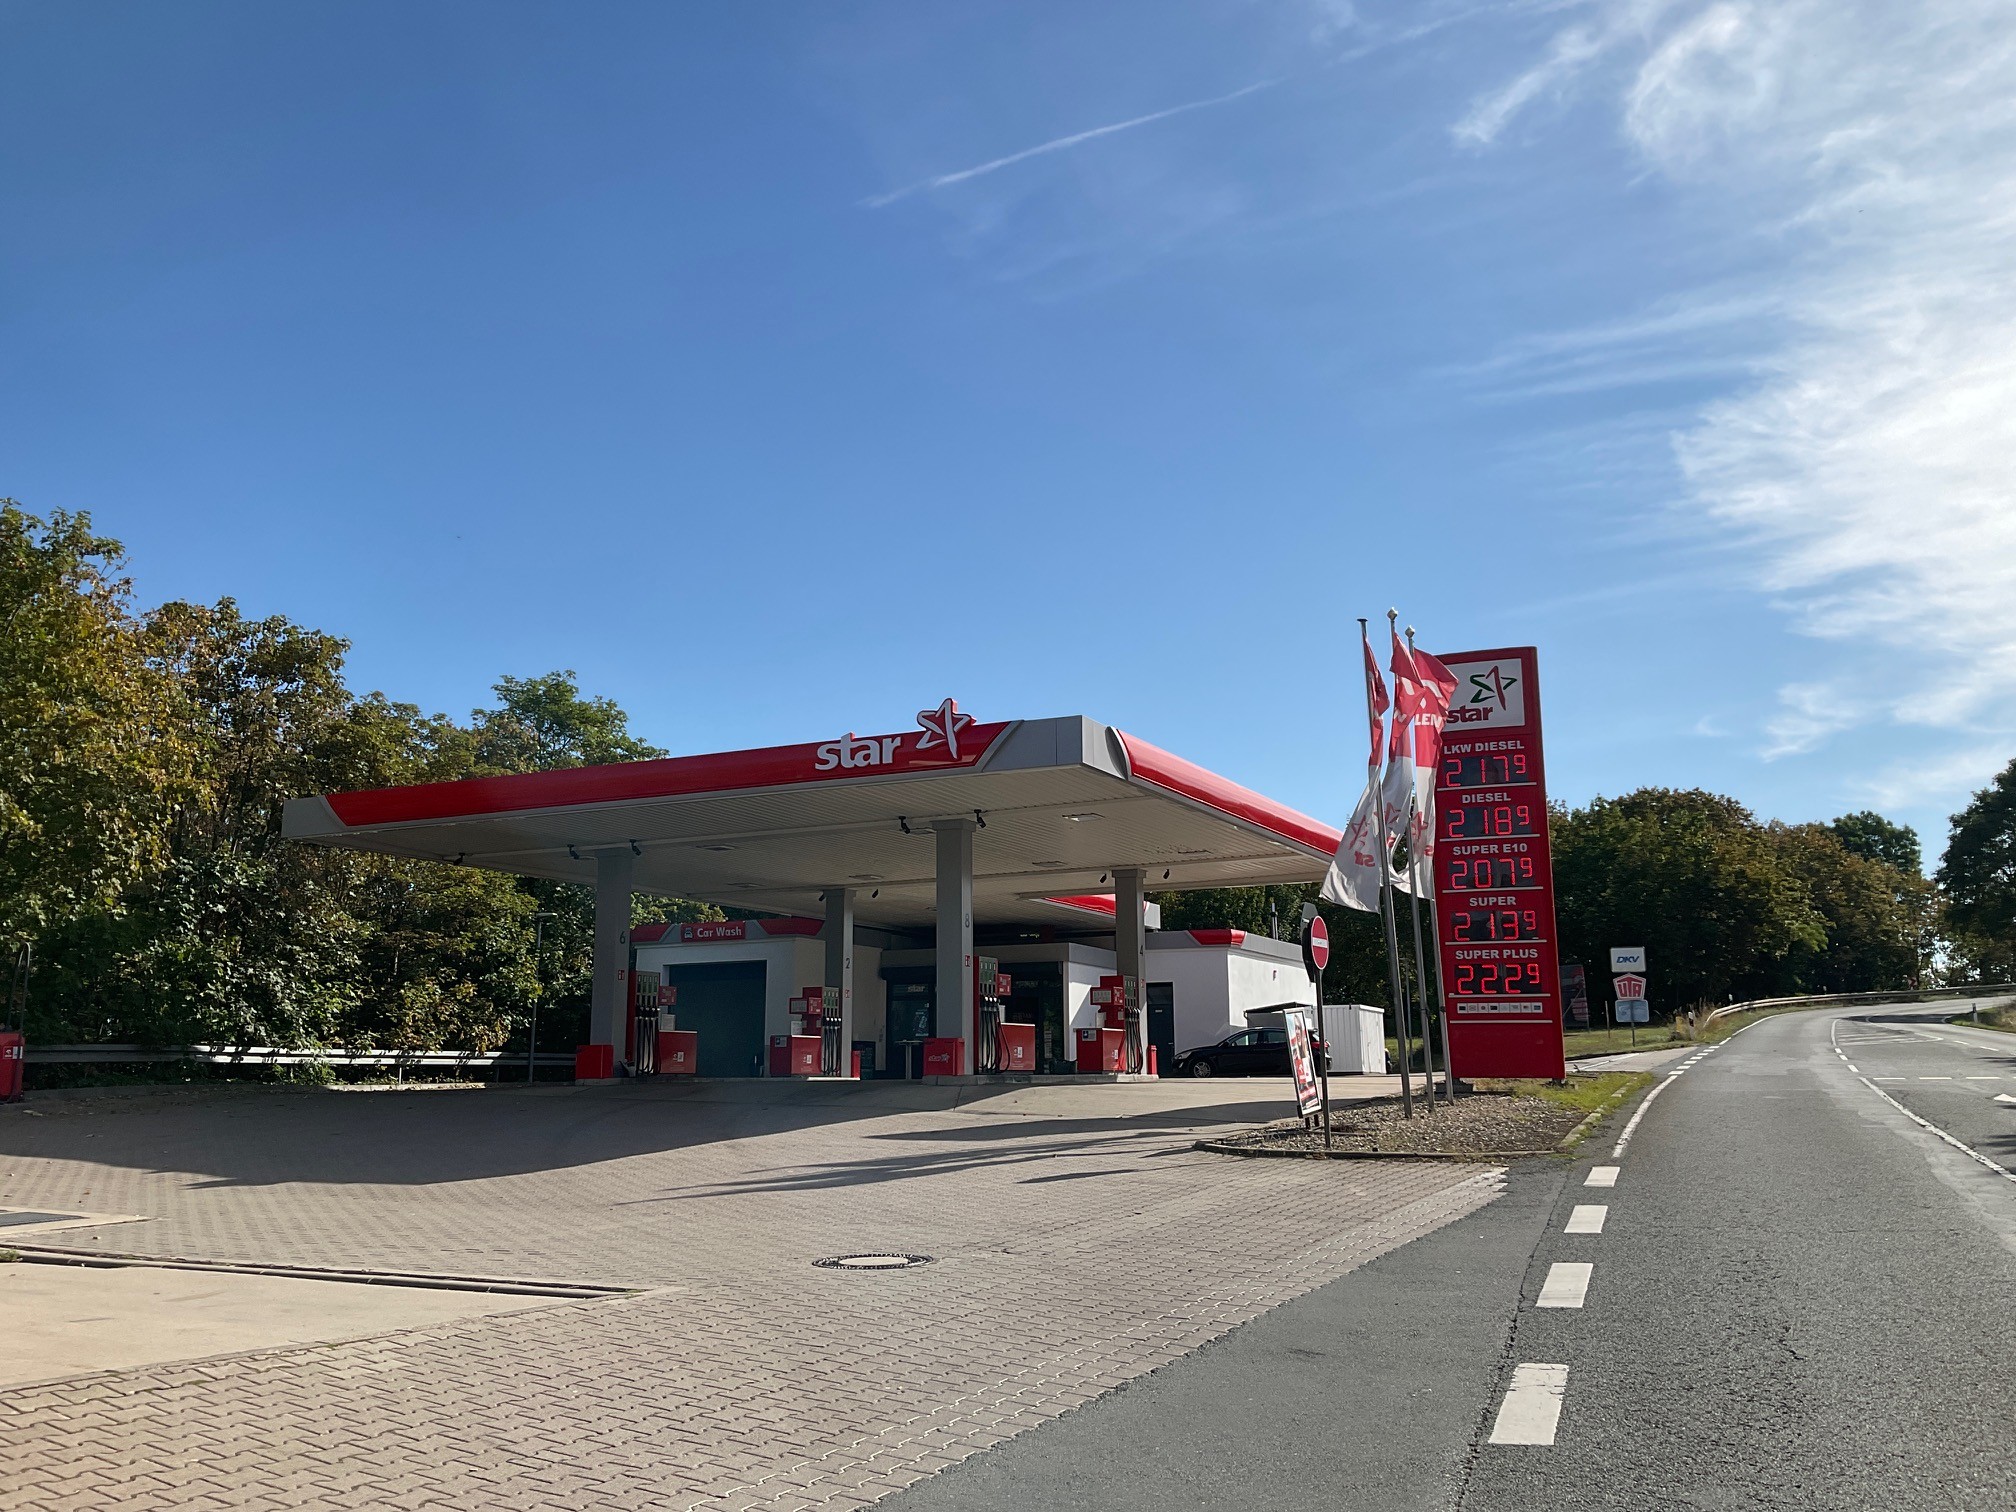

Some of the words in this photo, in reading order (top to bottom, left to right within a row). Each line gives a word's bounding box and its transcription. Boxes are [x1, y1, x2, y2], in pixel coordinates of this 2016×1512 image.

[1446, 705, 1493, 724] star
[815, 732, 900, 771] star
[1443, 744, 1471, 755] LKW
[1475, 740, 1525, 752] DIESEL
[1462, 792, 1511, 804] DIESEL
[1453, 844, 1499, 856] SUPER
[1503, 843, 1528, 853] E10
[1469, 896, 1517, 907] SUPER
[620, 931, 626, 944] 6
[697, 928, 713, 938] Car
[716, 926, 742, 937] Wash
[1455, 949, 1500, 960] SUPER
[1503, 948, 1539, 959] PLUS
[1616, 955, 1640, 963] DKV
[845, 957, 851, 969] 2
[1617, 976, 1643, 997] UTA
